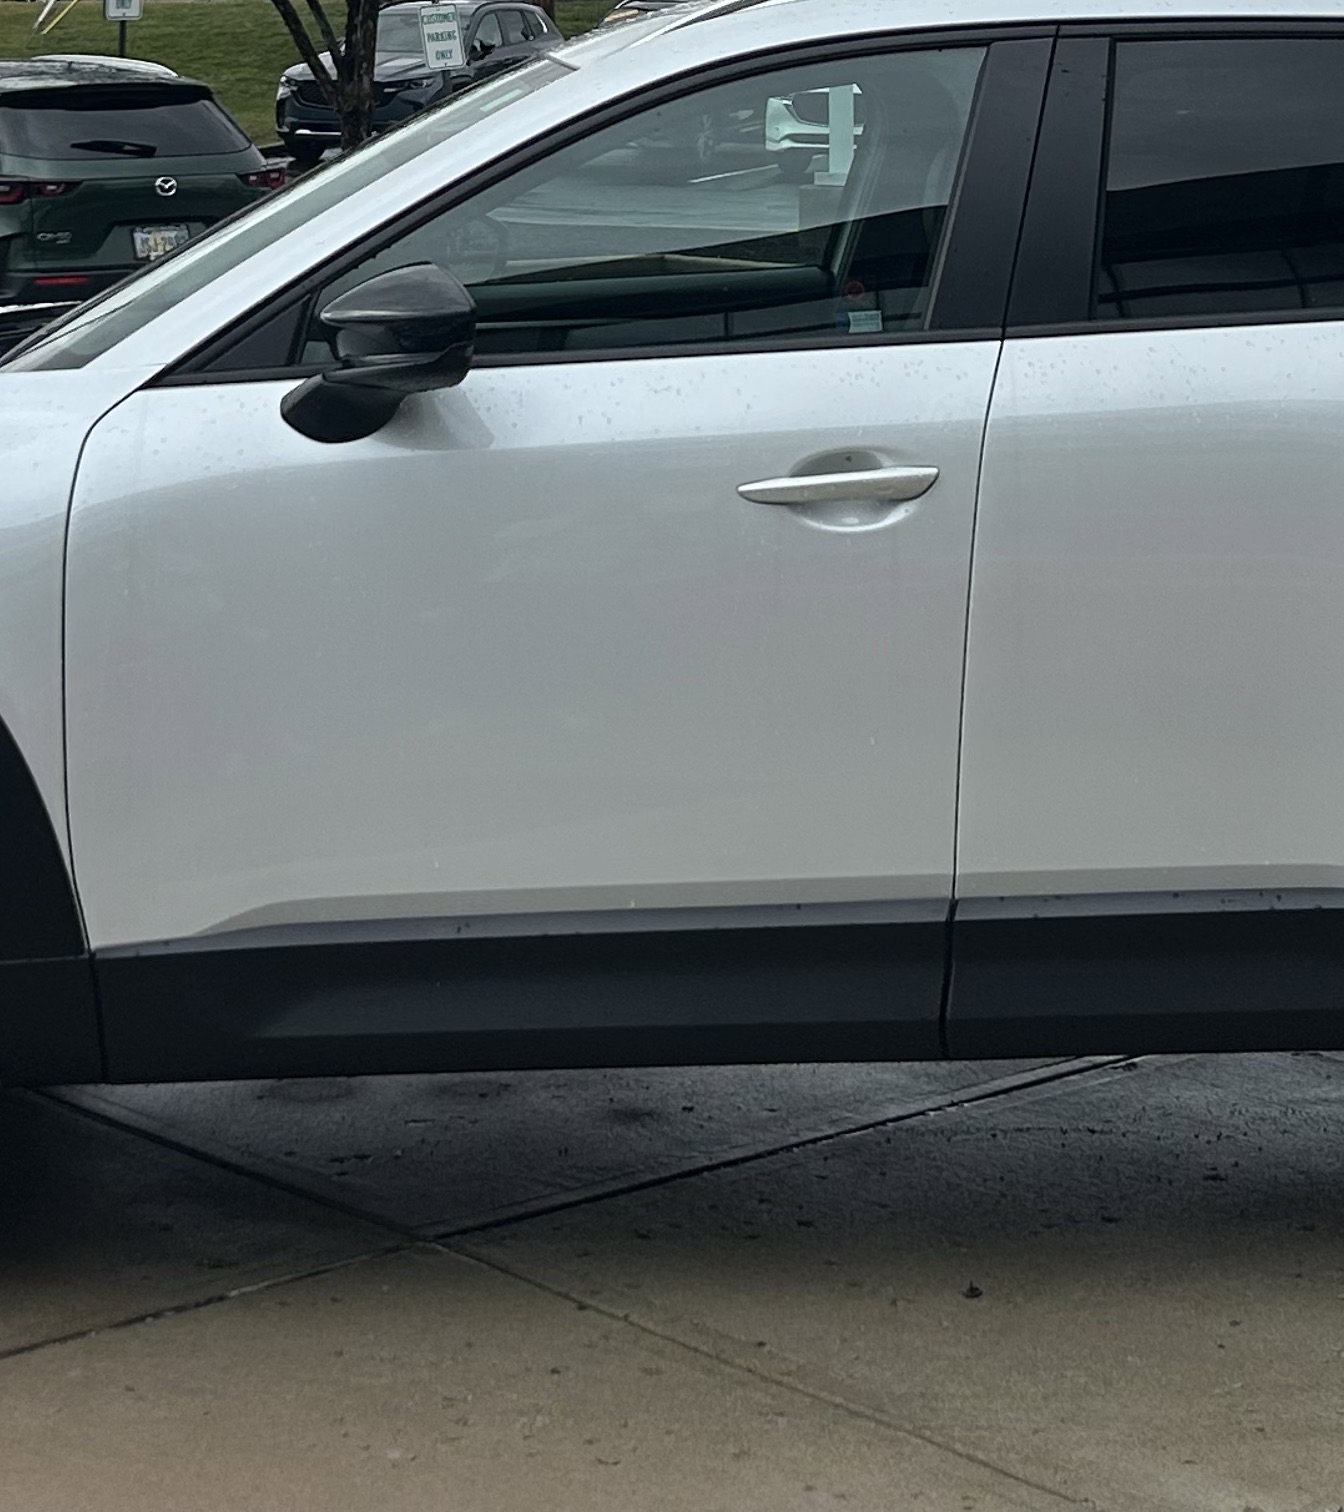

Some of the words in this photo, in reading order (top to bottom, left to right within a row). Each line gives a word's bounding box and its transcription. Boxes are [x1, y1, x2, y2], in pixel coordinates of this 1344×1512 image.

[421, 12, 456, 25] CUSTOMER
[427, 30, 457, 43] PARKING
[436, 49, 453, 61] ONLY
